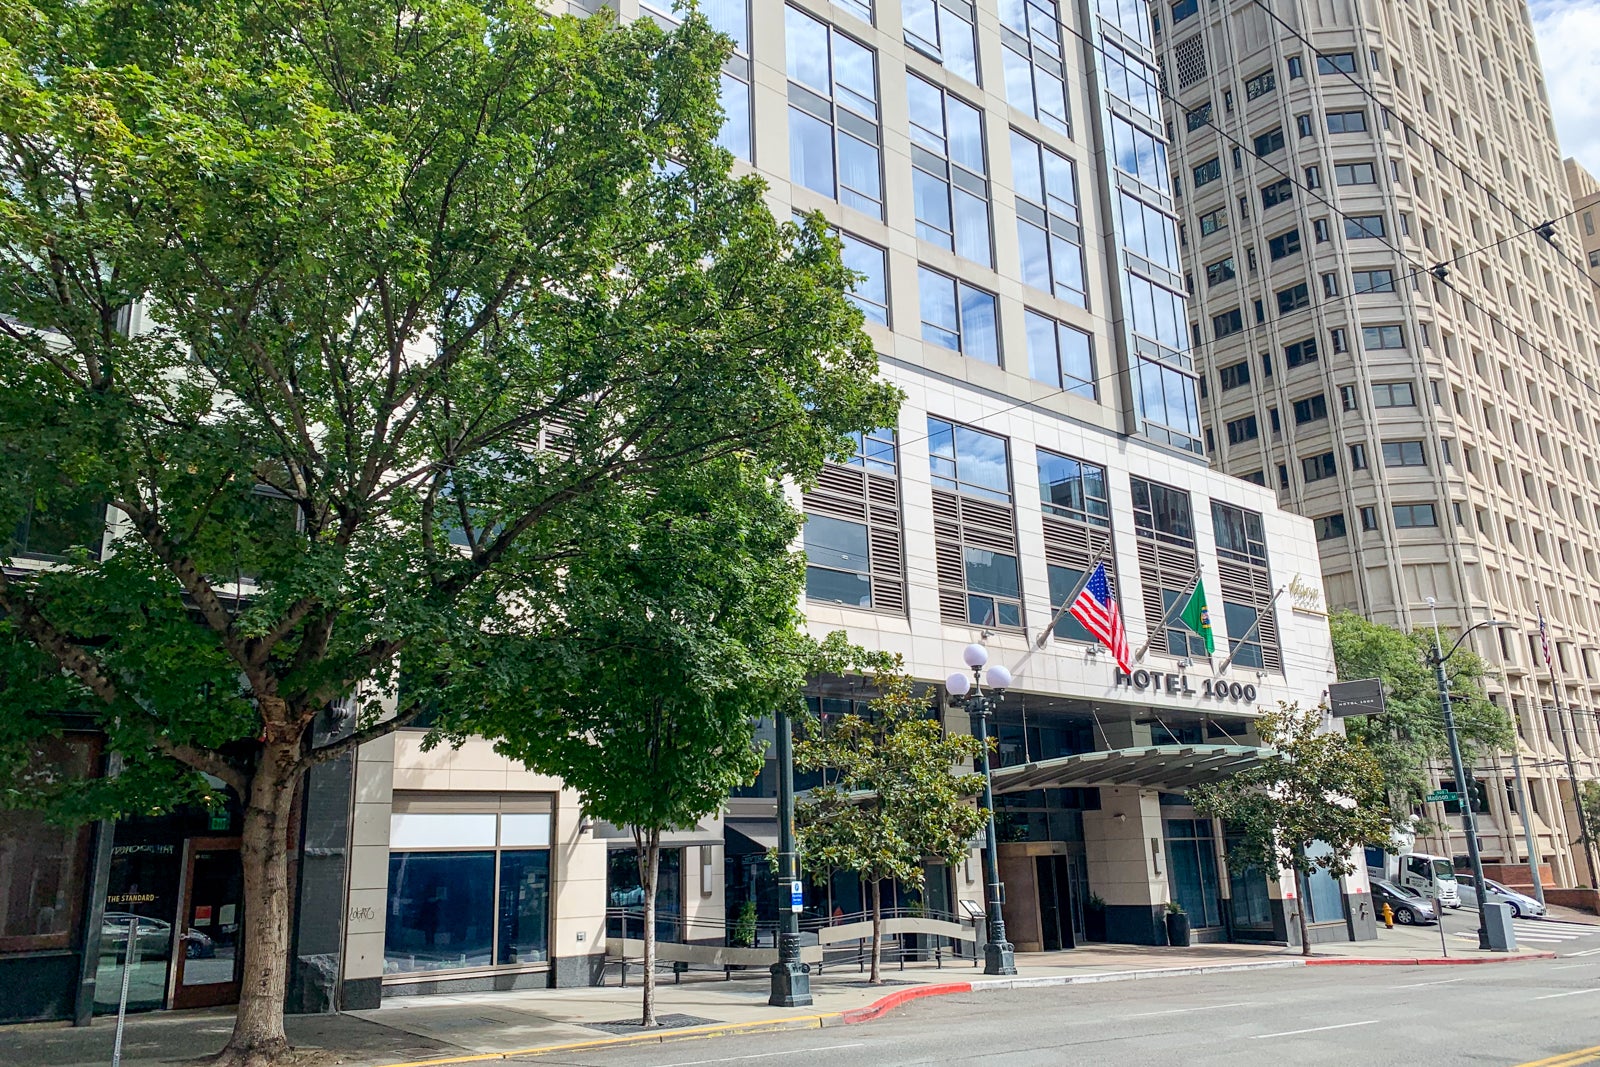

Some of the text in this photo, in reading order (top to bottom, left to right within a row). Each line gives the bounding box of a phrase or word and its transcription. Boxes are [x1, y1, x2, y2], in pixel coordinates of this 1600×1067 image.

[1115, 667, 1256, 701] HOTEL 1000
[107, 894, 154, 903] THE STANDARD
